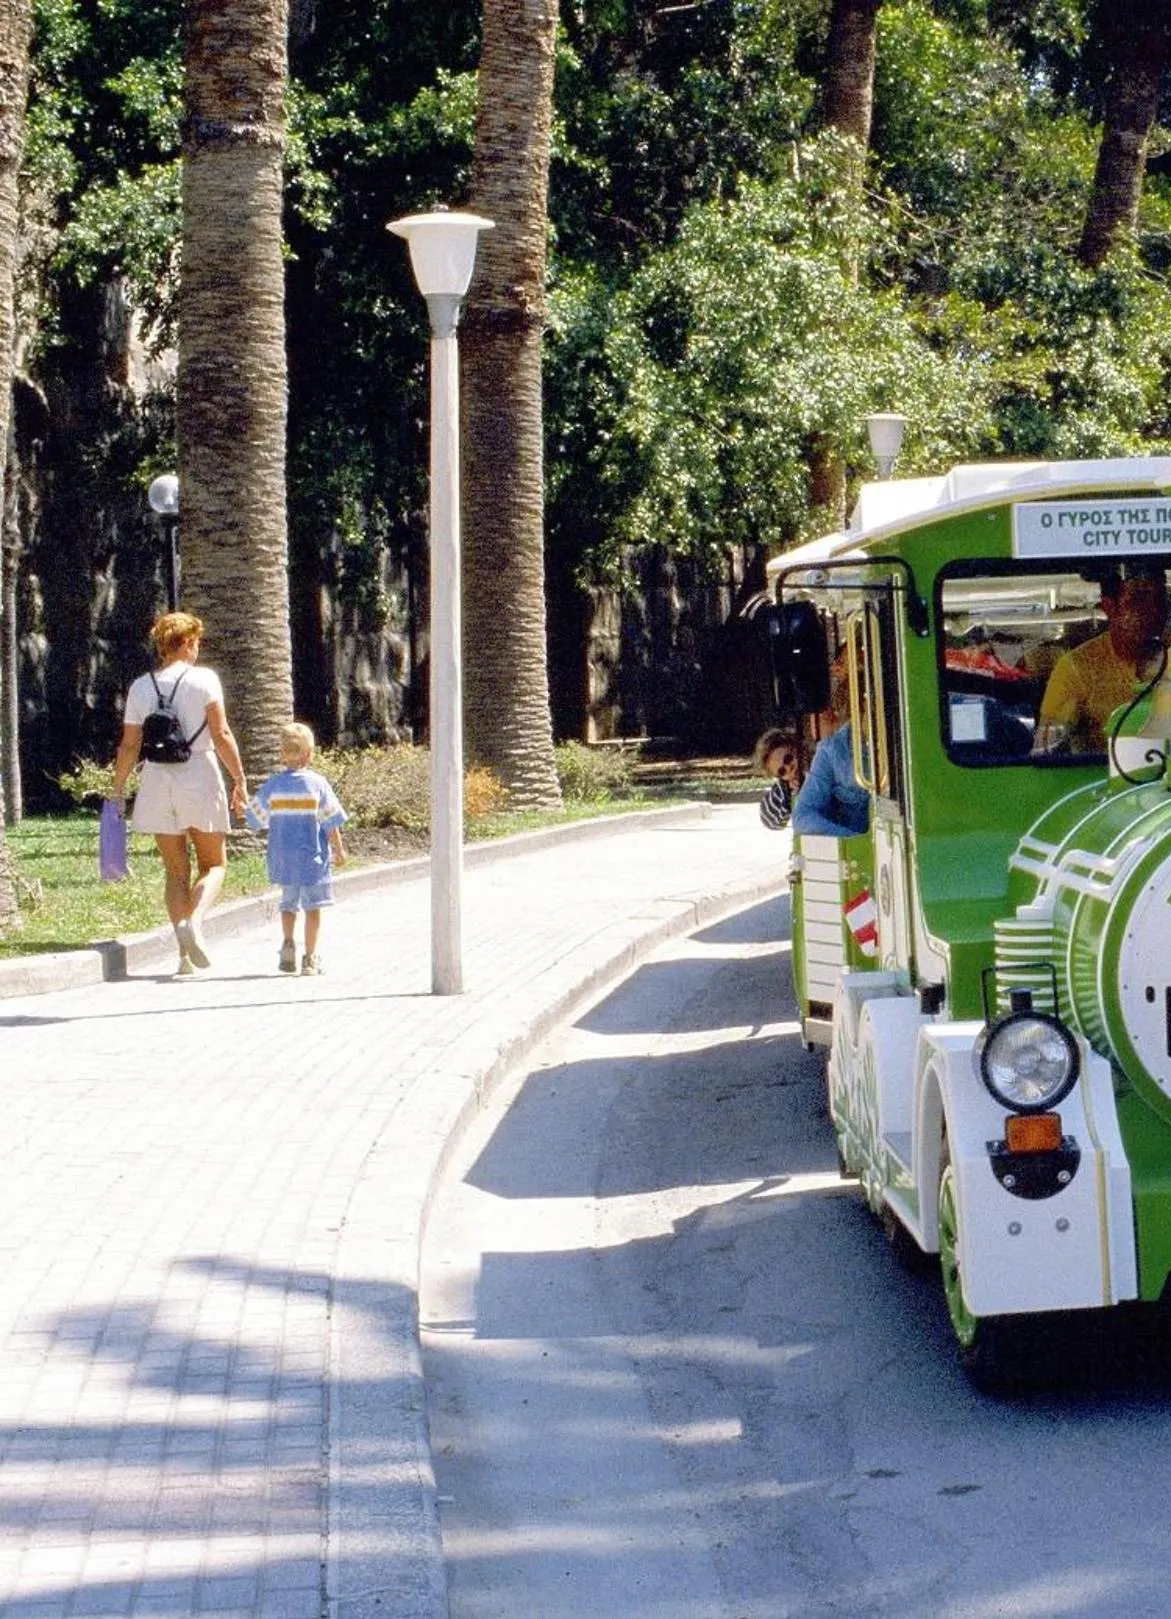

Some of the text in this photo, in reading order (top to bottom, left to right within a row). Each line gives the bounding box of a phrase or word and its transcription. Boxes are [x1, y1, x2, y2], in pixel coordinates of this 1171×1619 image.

[1058, 509, 1114, 527] ΓΥΡΟΣ
[1118, 508, 1151, 525] ΤΗΣ
[1083, 529, 1122, 547] CITY
